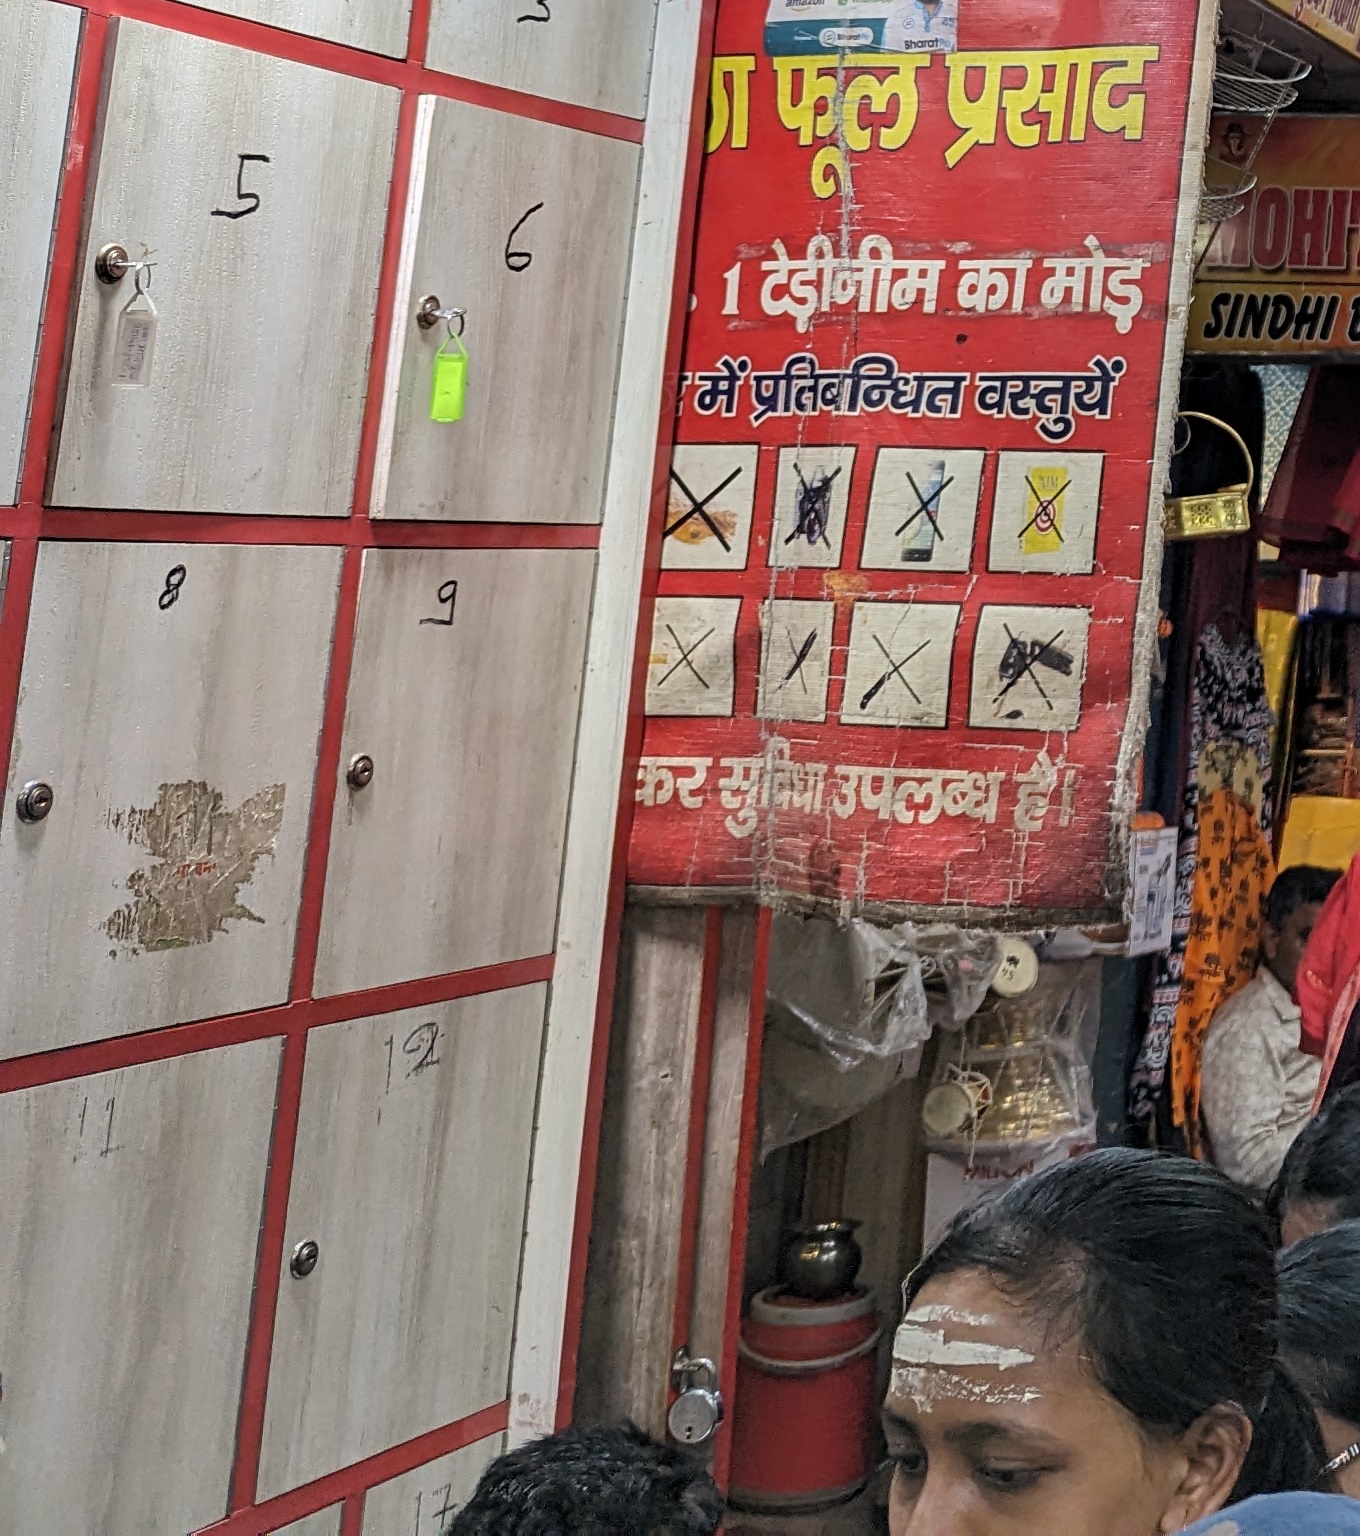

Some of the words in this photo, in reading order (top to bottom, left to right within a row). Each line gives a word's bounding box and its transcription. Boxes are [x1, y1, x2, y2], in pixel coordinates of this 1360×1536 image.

[773, 54, 931, 200] फूल
[944, 44, 1160, 168] प्रसाद
[211, 154, 270, 219] 5
[505, 202, 544, 272] 6
[956, 258, 1033, 314] का
[1040, 233, 1152, 335] मोड़
[1203, 292, 1340, 343] SINDHI
[693, 354, 753, 418] में
[750, 352, 968, 428] प्रतिबन्धित
[975, 354, 1128, 444] वस्तुयें
[158, 564, 187, 611] 8
[419, 579, 460, 626] 9
[833, 765, 1006, 825] उपलब्ध
